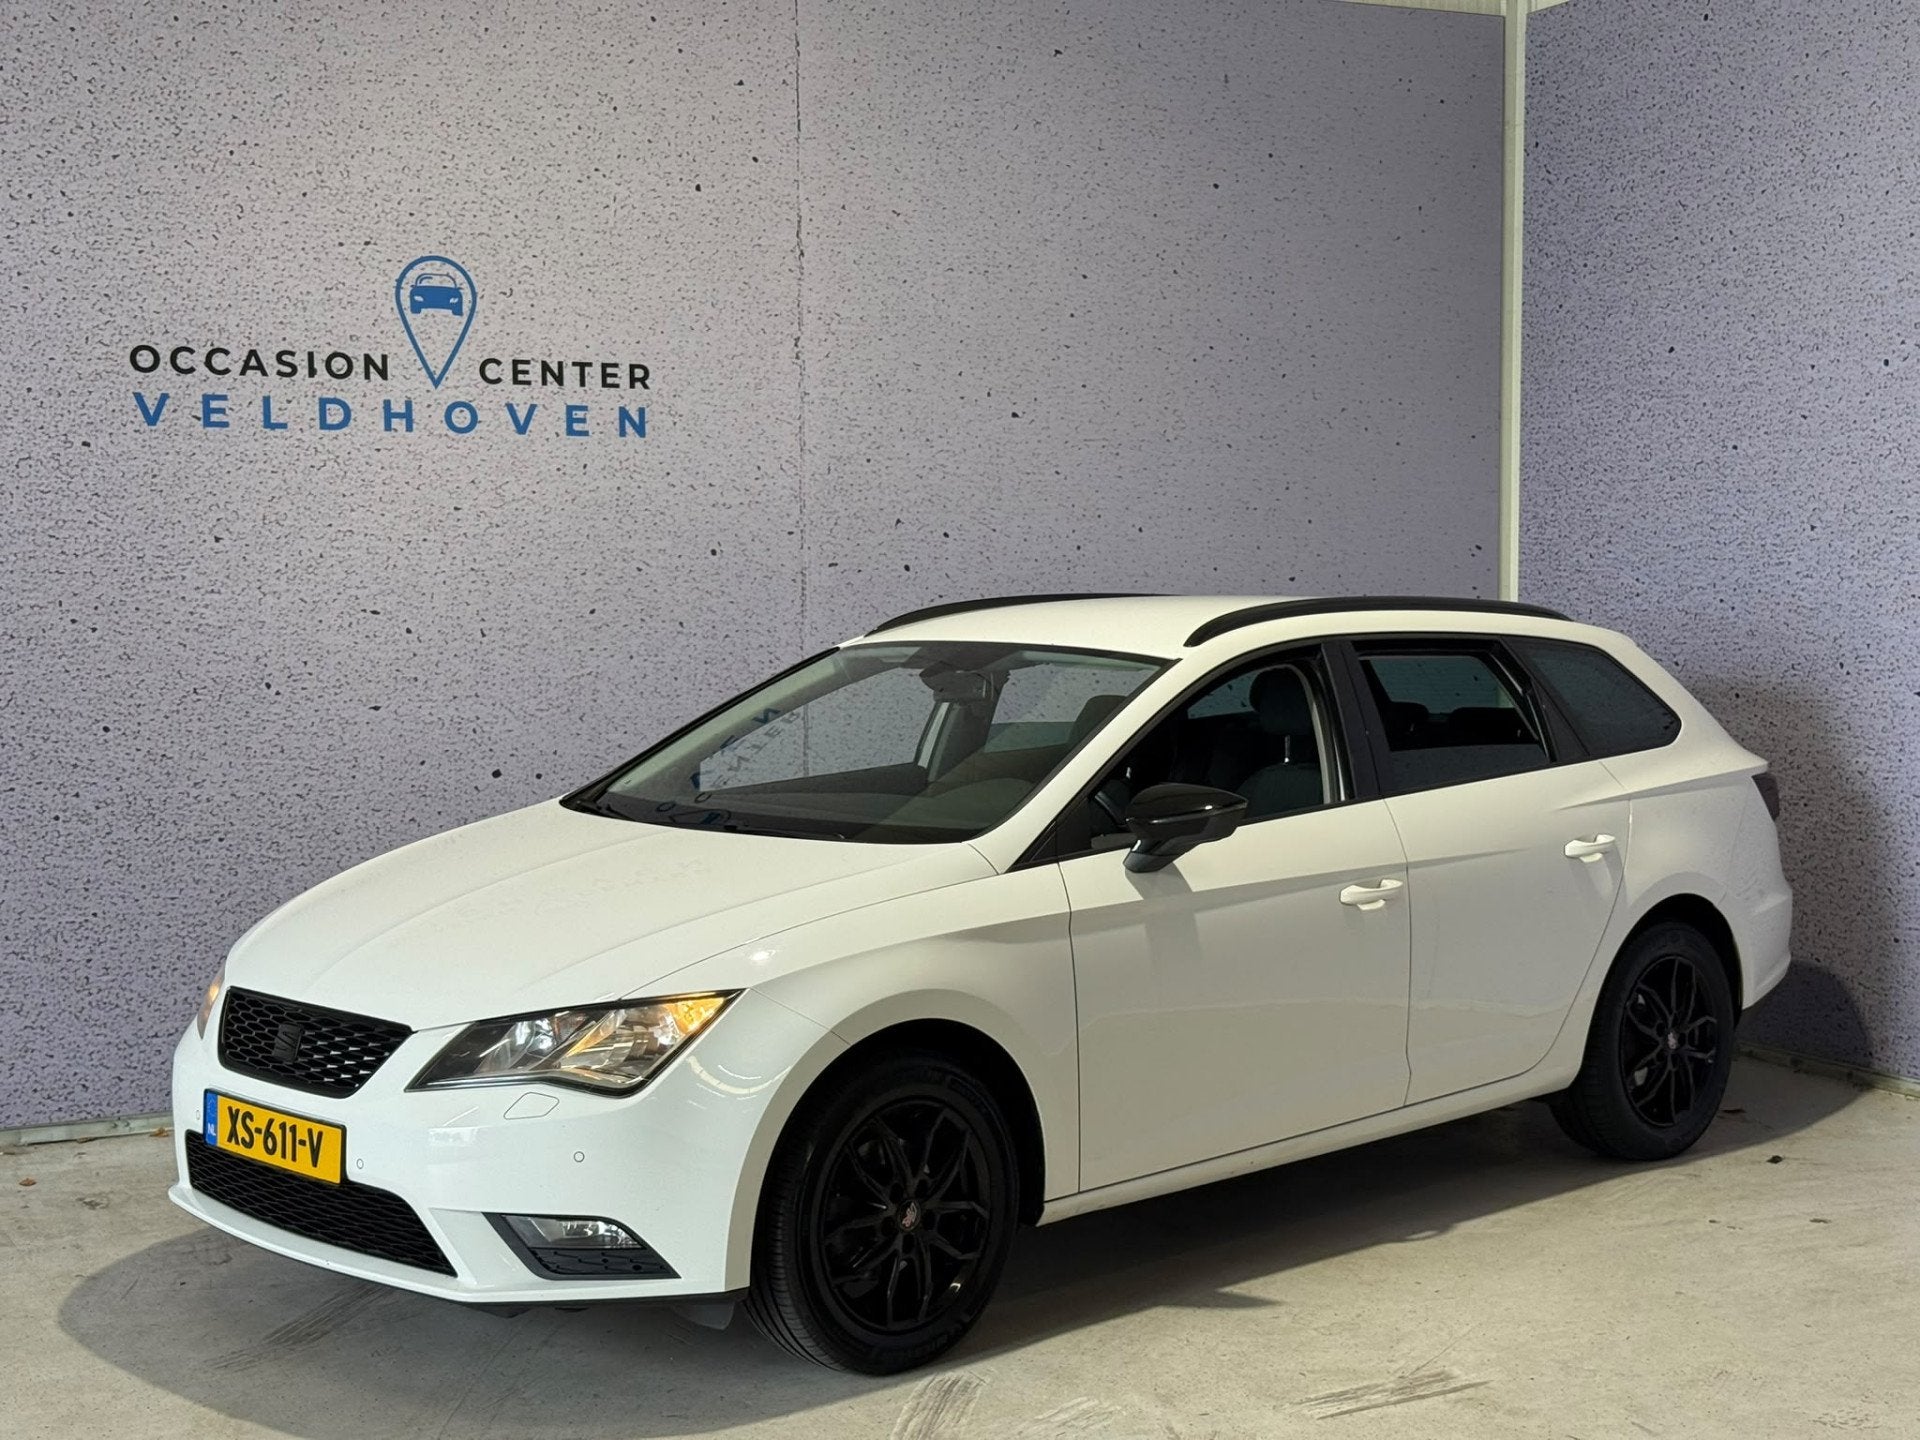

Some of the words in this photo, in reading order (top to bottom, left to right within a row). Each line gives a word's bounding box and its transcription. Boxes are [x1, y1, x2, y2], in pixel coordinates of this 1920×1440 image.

[129, 344, 389, 381] OCCASION
[478, 357, 651, 390] CENTER
[132, 391, 647, 439] VELDHOVEN
[207, 1122, 217, 1137] NL
[226, 1105, 324, 1168] XS-611-V
